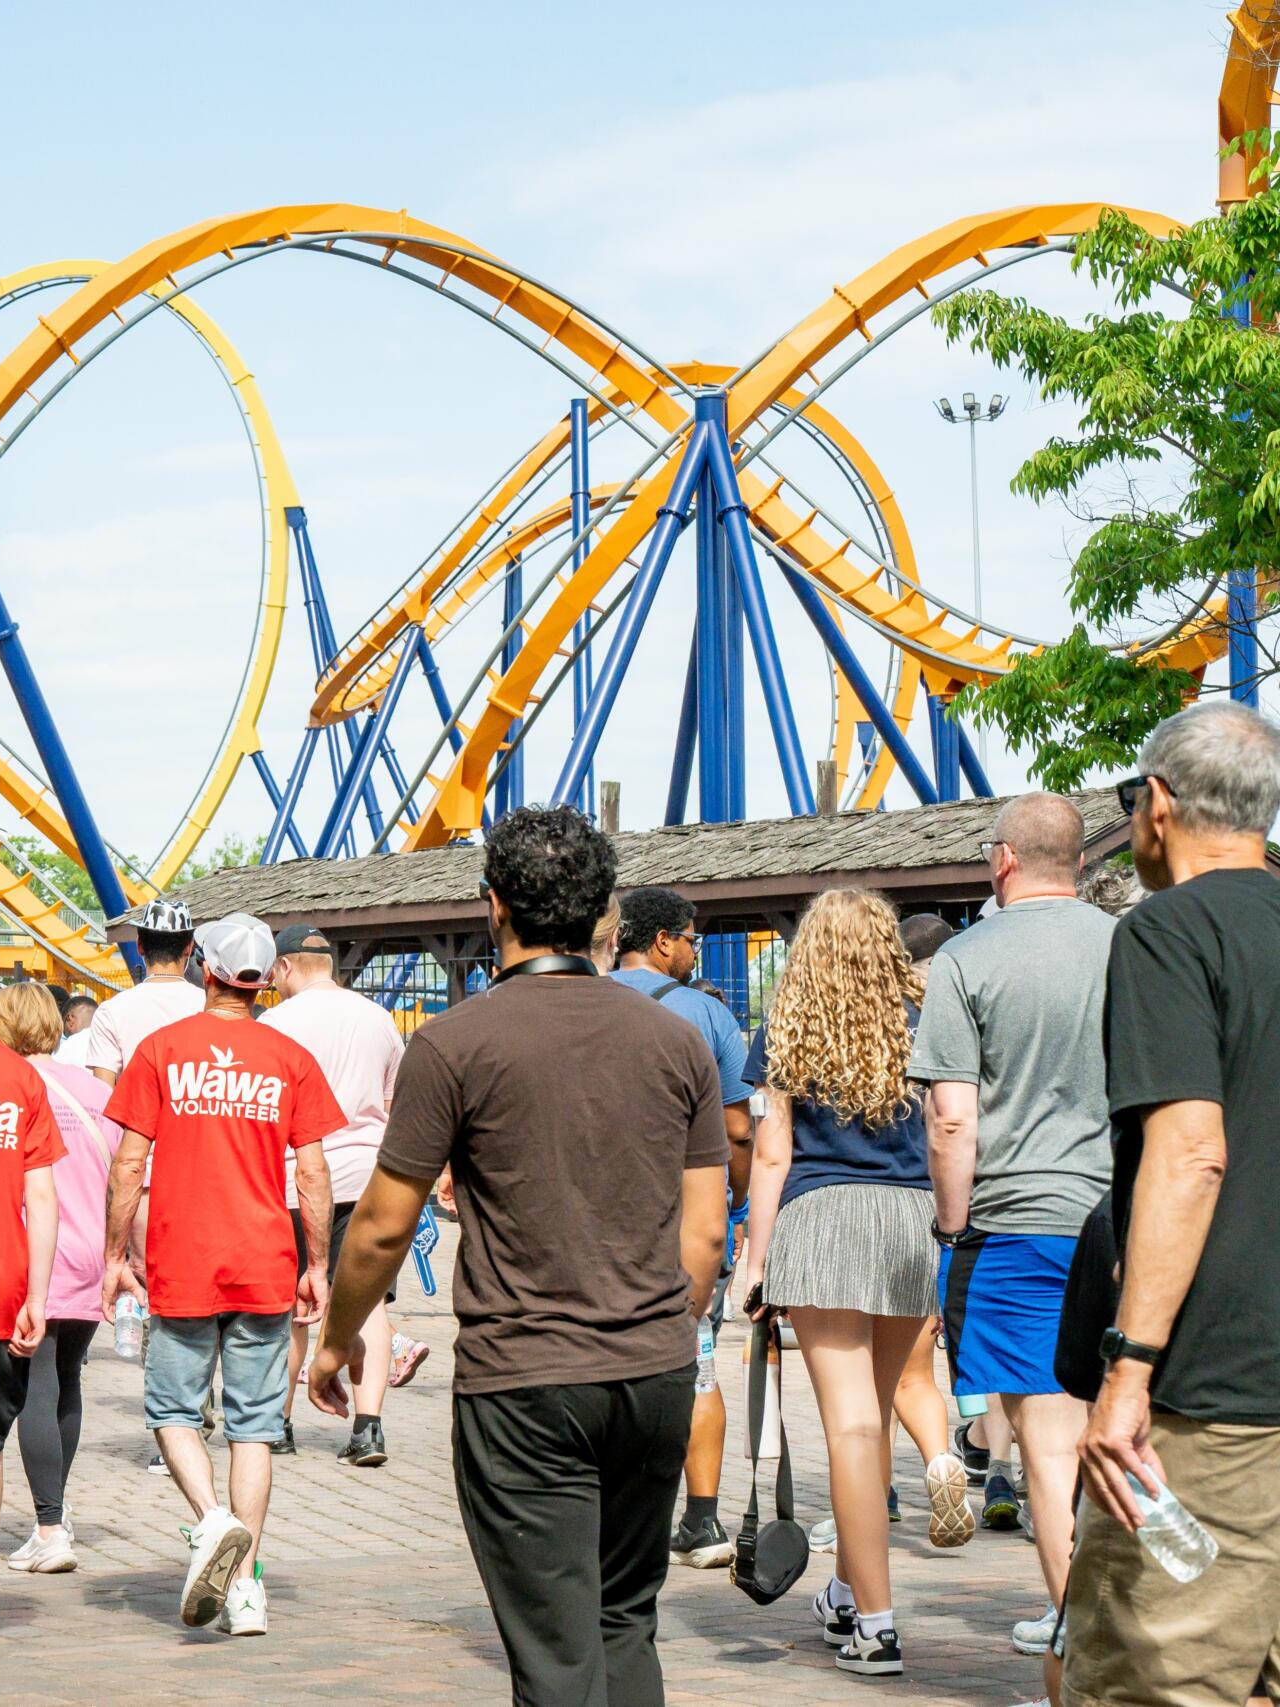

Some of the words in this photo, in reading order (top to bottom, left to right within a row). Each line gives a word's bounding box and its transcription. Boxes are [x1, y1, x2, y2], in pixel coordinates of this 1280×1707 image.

[168, 1061, 282, 1108] Wawa
[170, 1099, 280, 1124] VOLUNTEER
[881, 1632, 896, 1641] NIKE
